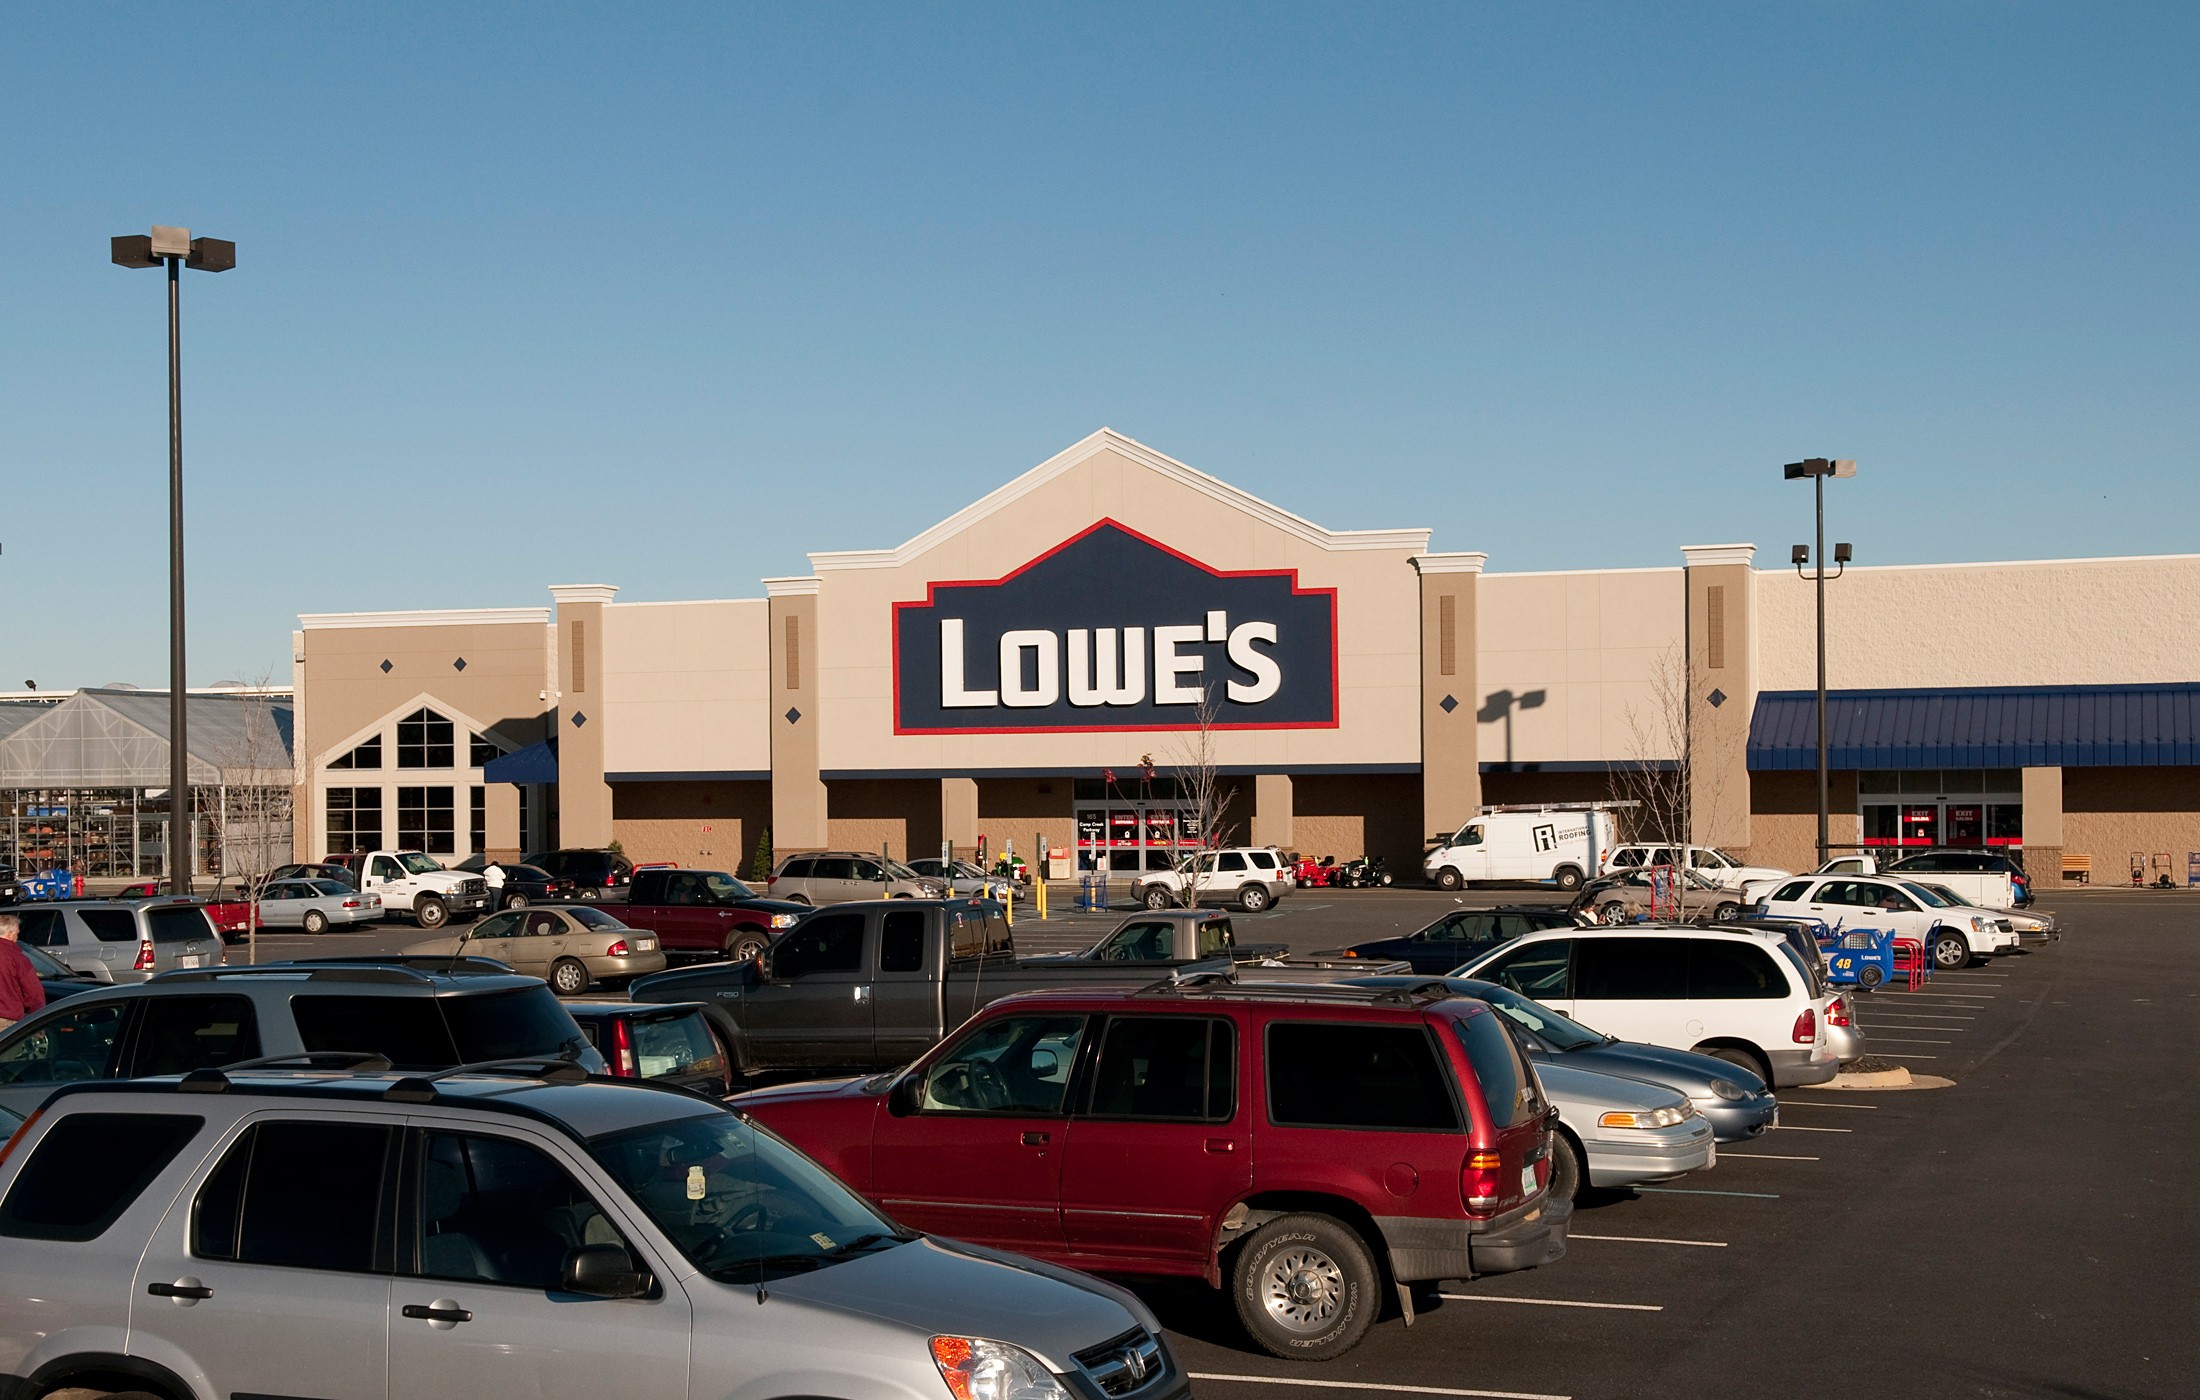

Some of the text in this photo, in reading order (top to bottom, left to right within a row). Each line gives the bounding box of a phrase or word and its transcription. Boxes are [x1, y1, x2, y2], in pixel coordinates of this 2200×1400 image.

[940, 609, 1282, 708] LOWE'S
[1558, 829, 1592, 841] ROOFING
[1835, 958, 1852, 969] 48
[1290, 1281, 1358, 1348] WRANGLER
